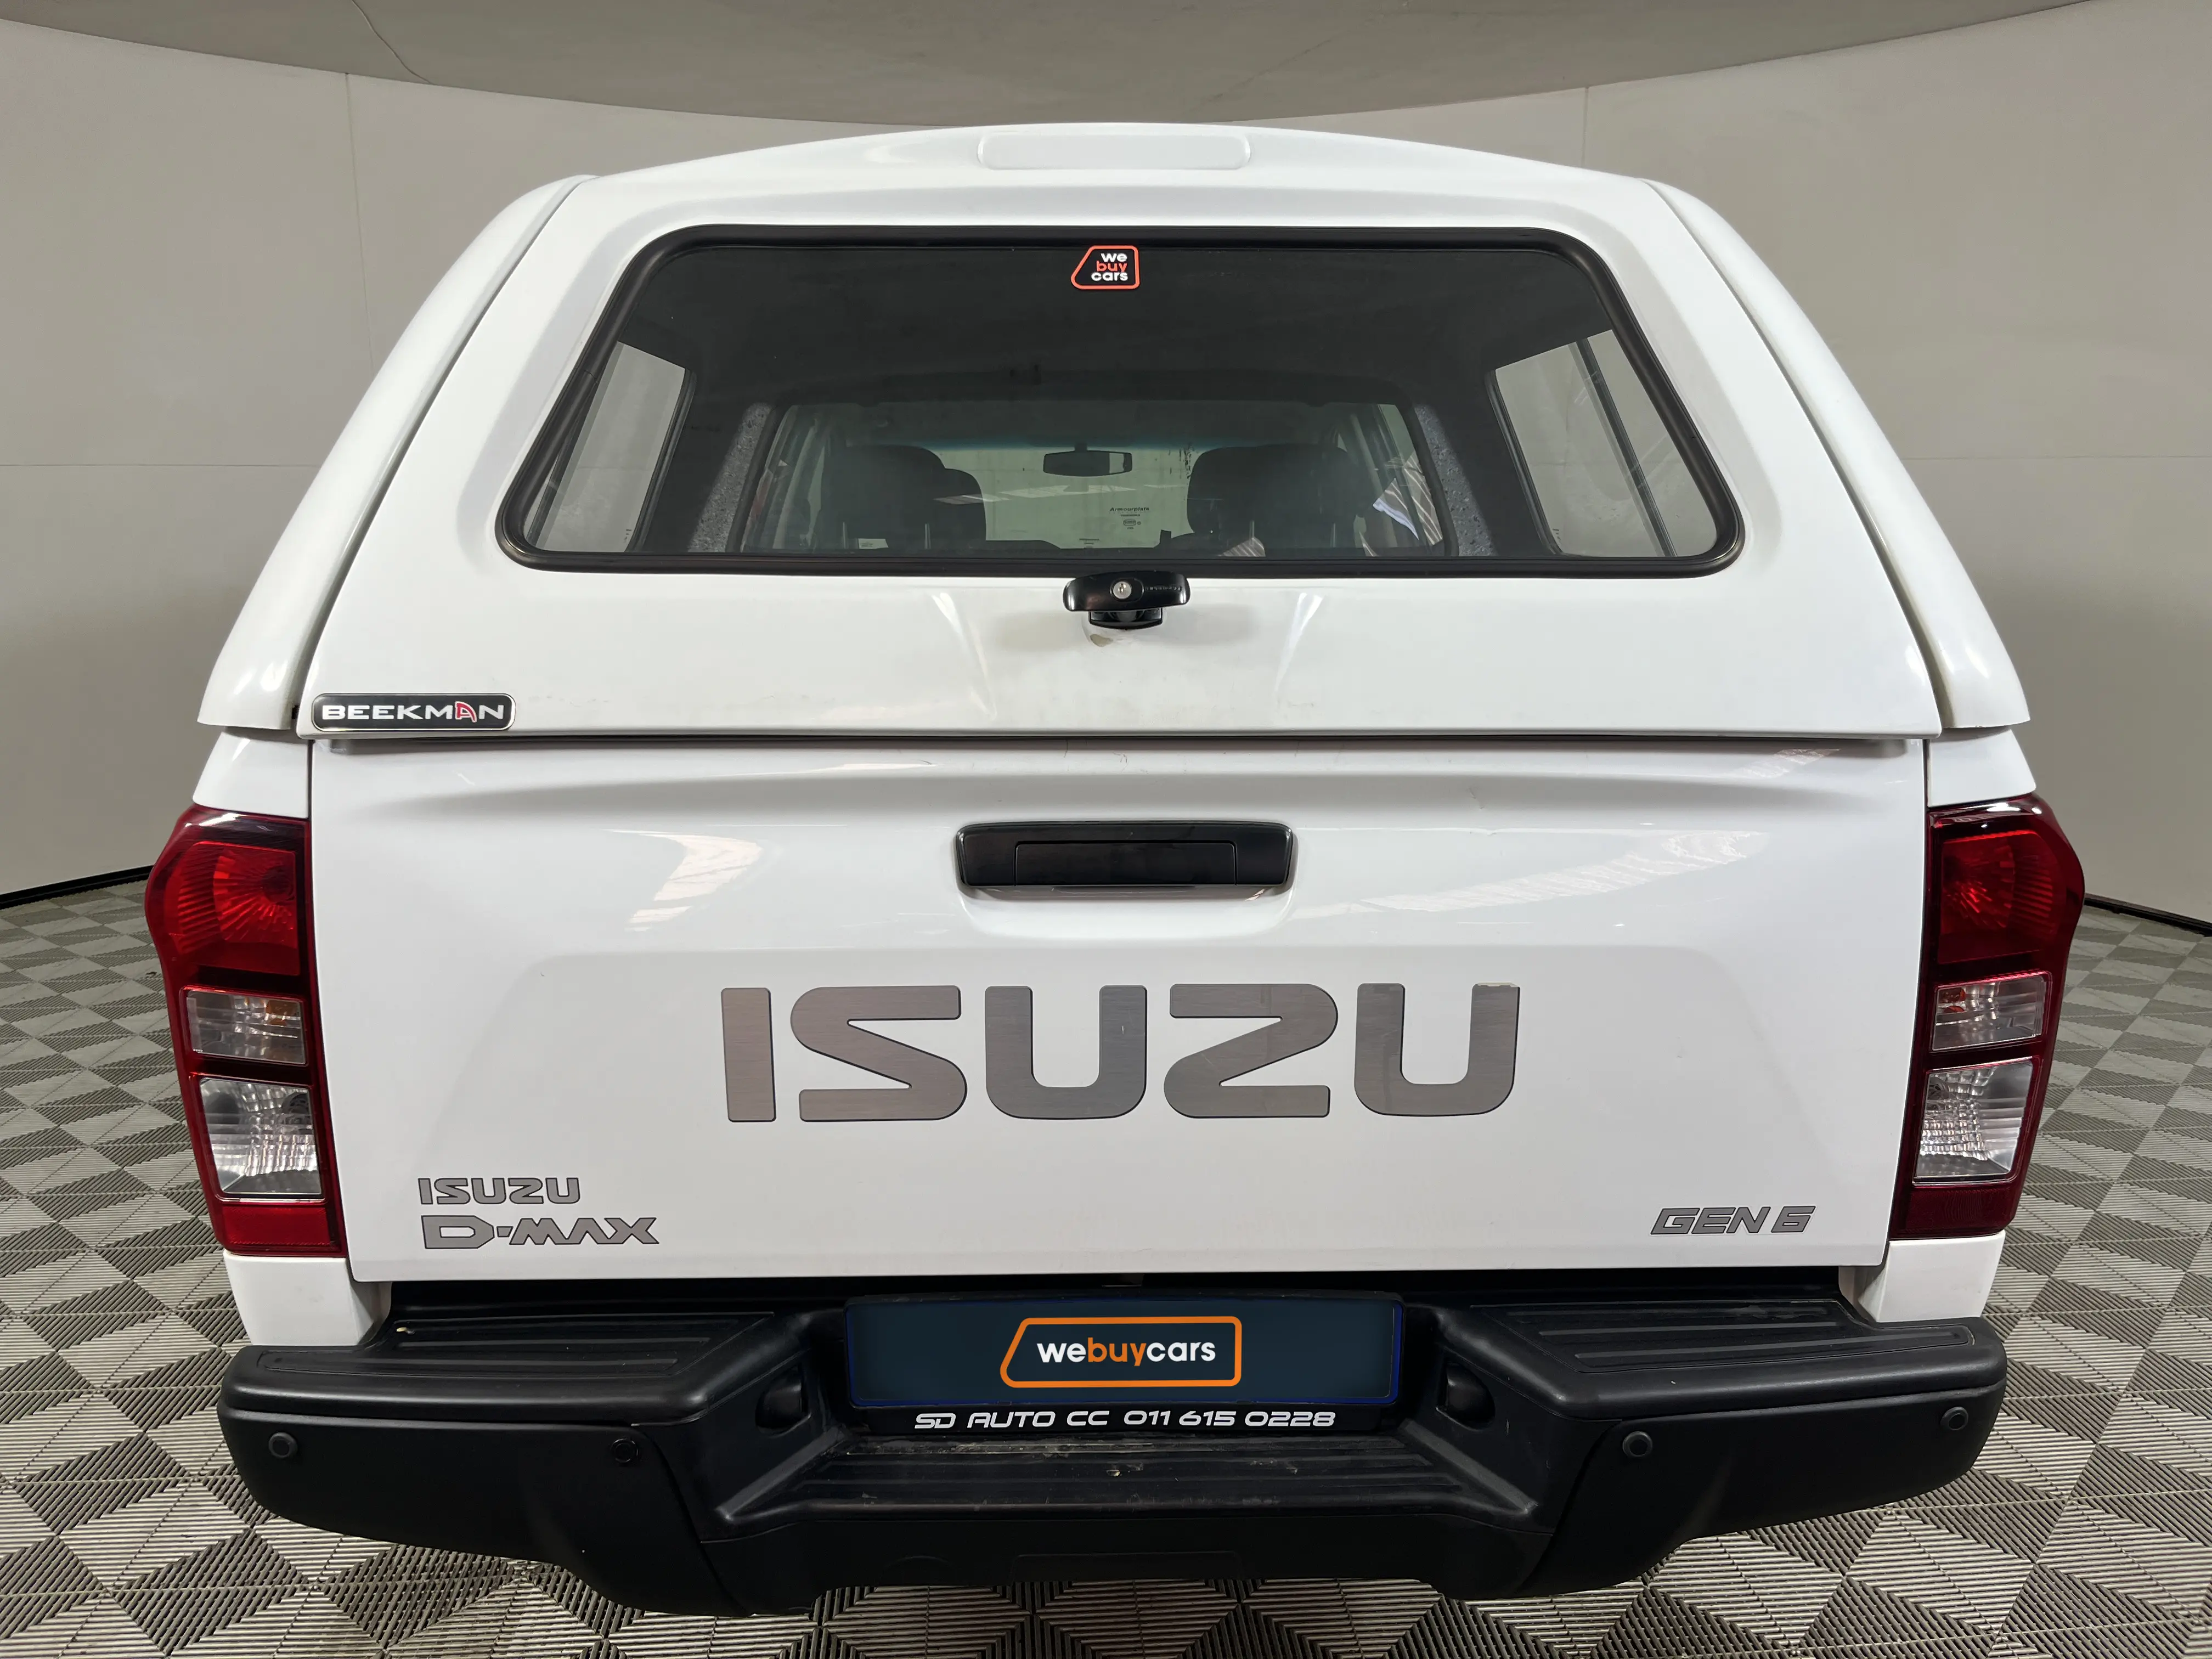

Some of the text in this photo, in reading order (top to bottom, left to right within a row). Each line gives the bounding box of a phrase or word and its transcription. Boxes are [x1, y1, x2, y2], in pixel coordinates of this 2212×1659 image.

[1096, 261, 1127, 273] buy
[1101, 253, 1127, 262] we
[1091, 272, 1128, 281] cars
[322, 701, 504, 723] BEEKMAN
[721, 983, 1521, 1122] ISUZU
[417, 1177, 580, 1205] ISUZU
[1650, 1205, 1816, 1235] GEN 6
[421, 1215, 660, 1249] D-MAX
[915, 1410, 1335, 1429] SD AUTO CC 011 615 0228
